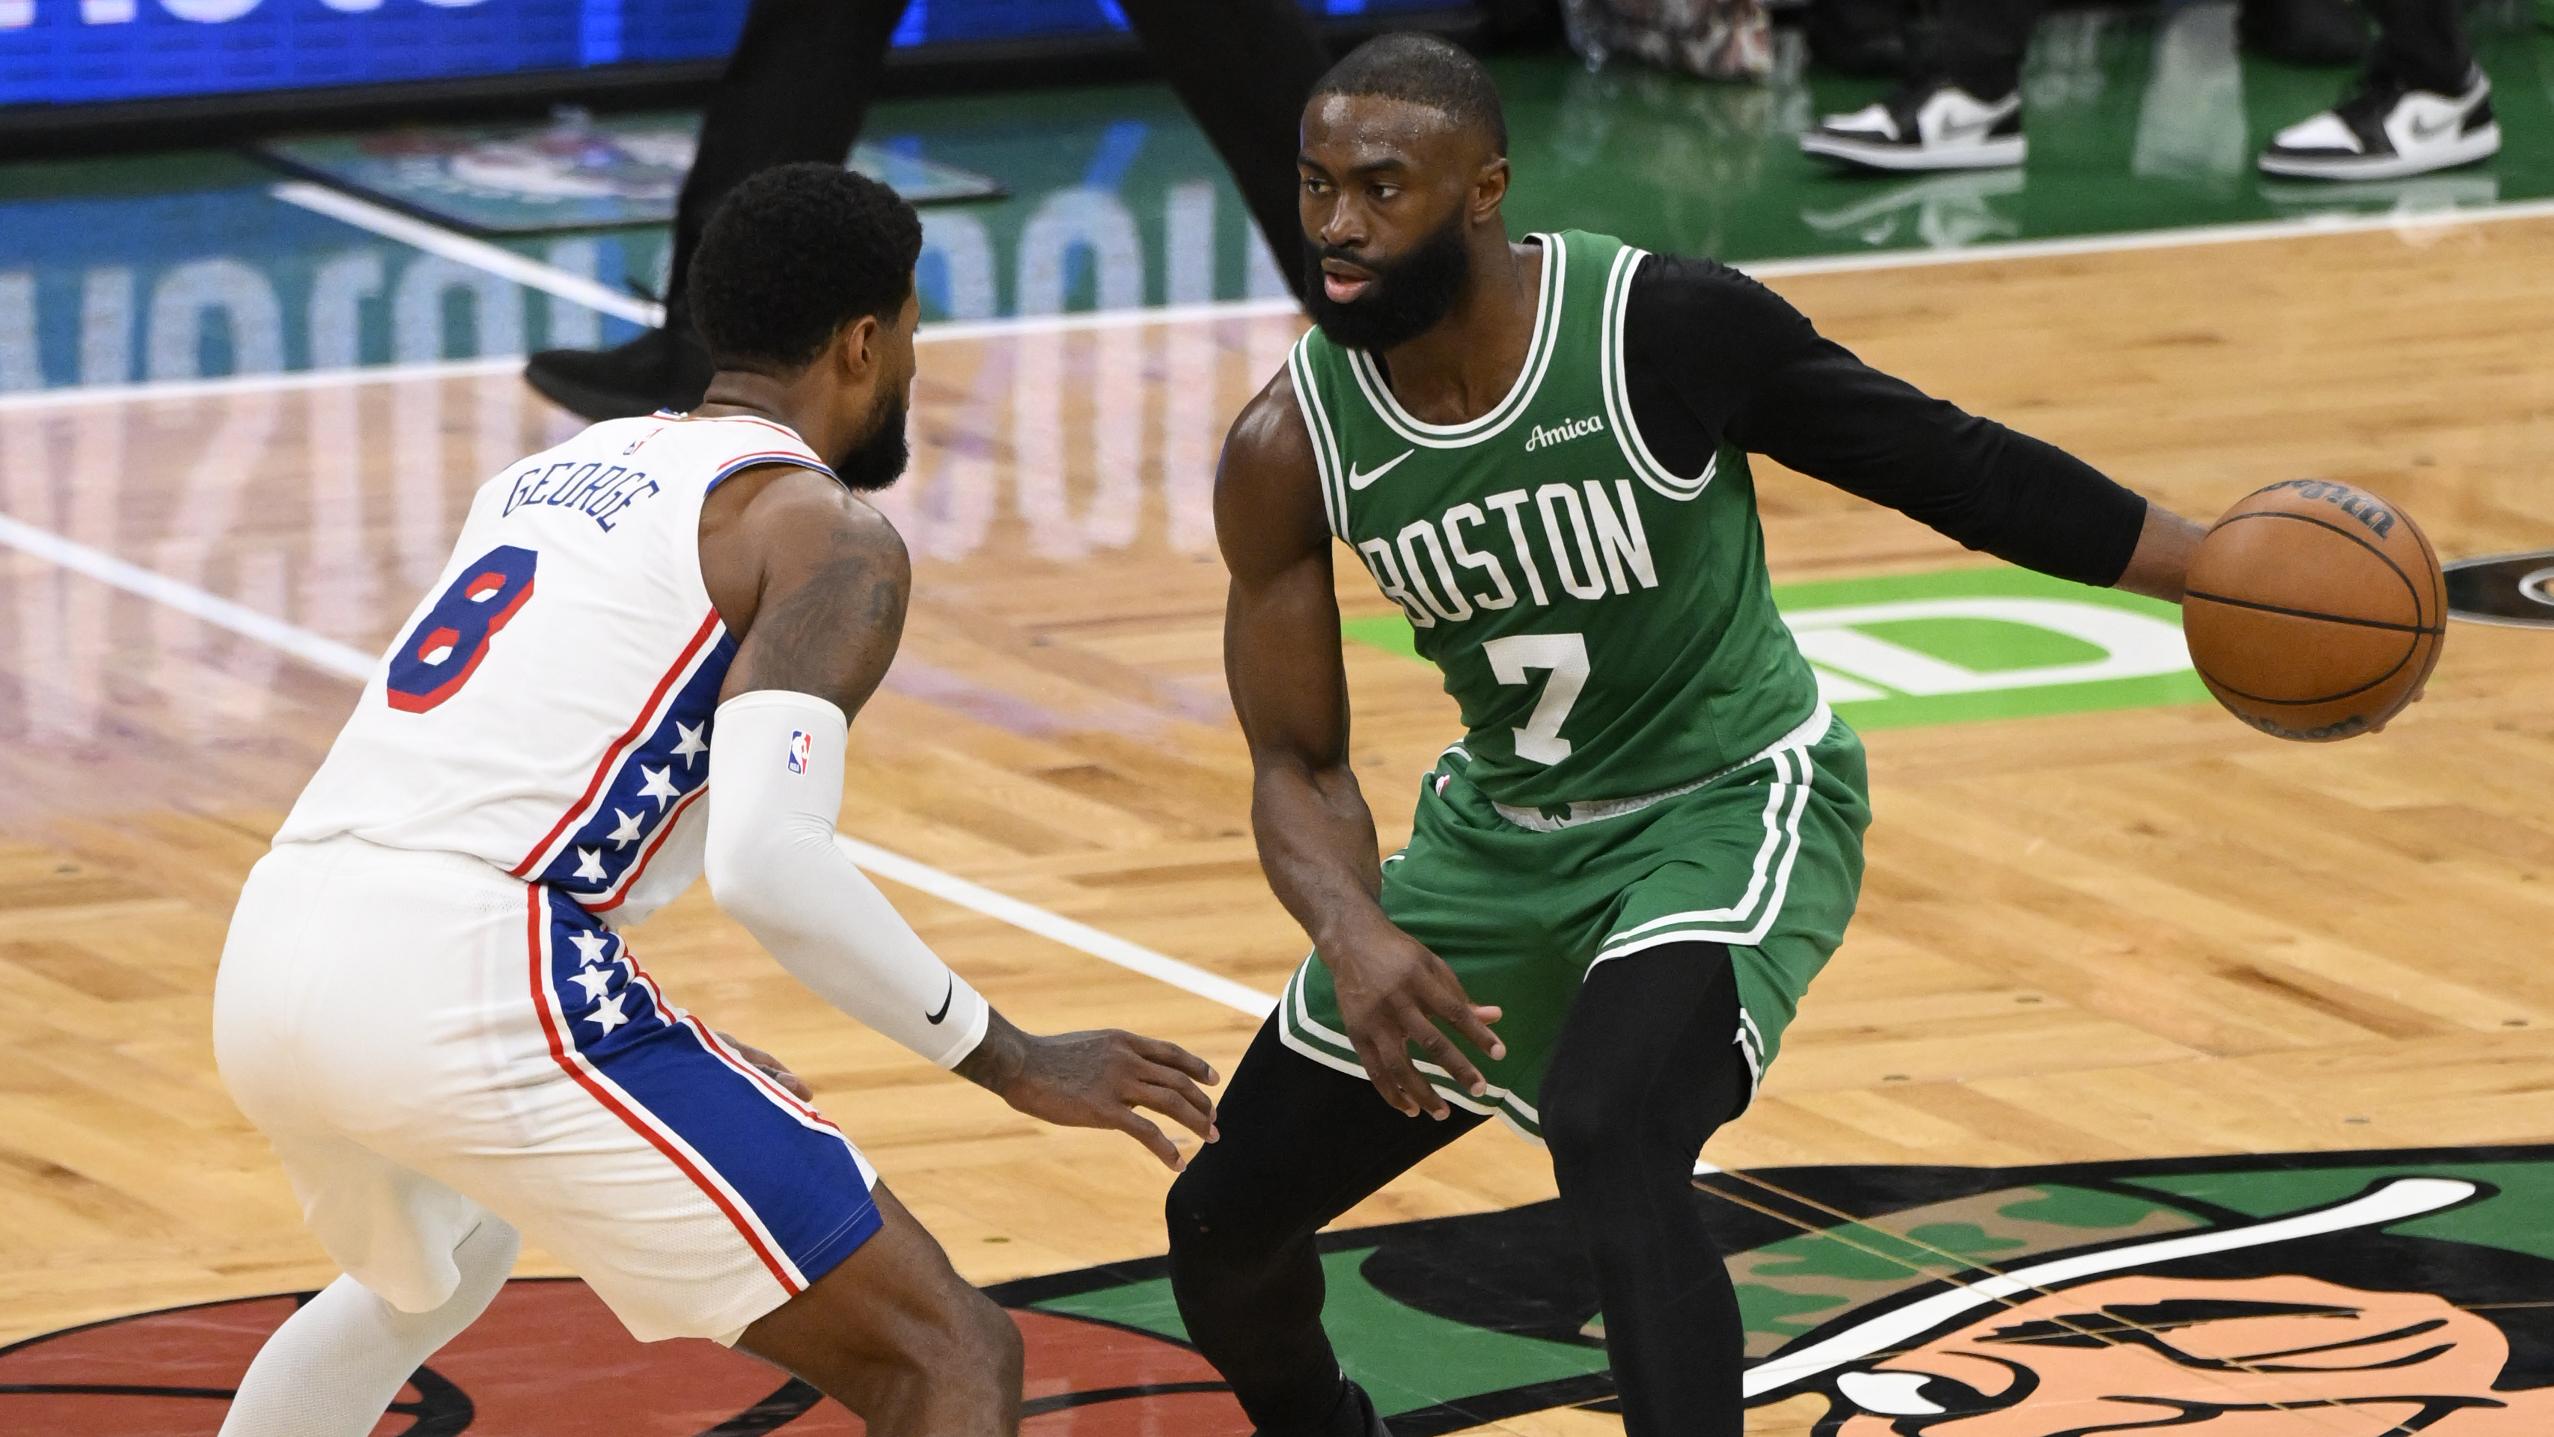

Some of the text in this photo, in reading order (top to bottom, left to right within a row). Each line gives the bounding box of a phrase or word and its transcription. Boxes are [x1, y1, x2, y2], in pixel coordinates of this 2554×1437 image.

[502, 462, 660, 533] GEORGE
[1525, 415, 1605, 452] Amica
[1357, 479, 1659, 629] BOSTON
[387, 544, 538, 714] 8
[1481, 632, 1591, 767] 7
